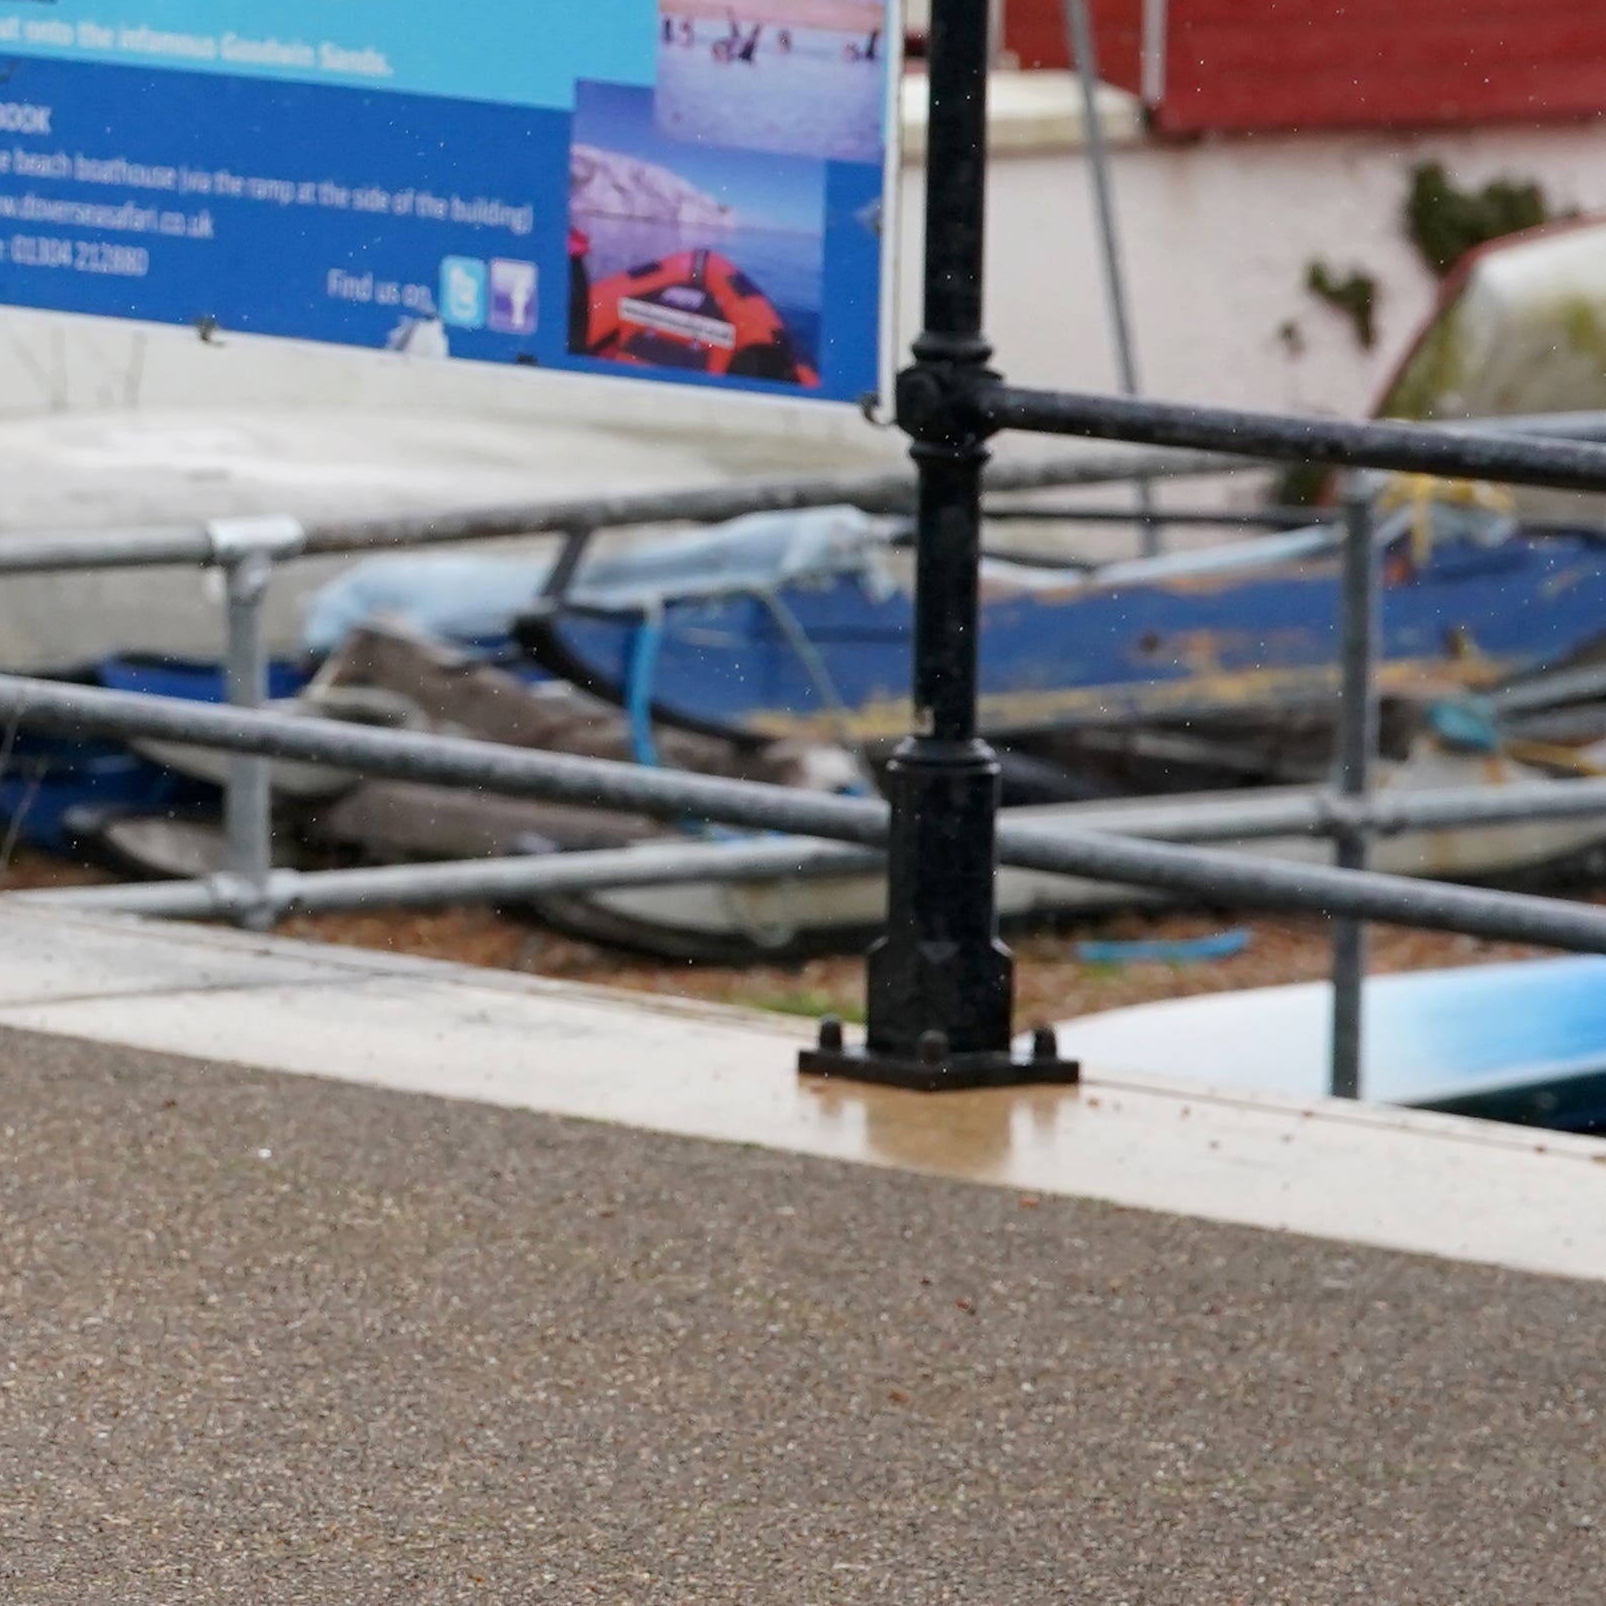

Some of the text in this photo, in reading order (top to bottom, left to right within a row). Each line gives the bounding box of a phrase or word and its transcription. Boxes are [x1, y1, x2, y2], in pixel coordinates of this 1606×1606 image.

[24, 21, 74, 45] onto
[77, 20, 114, 48] the
[119, 25, 216, 58] infamous
[221, 33, 314, 66] Goodwin
[13, 147, 73, 180] beach
[74, 152, 176, 191] boathouse
[213, 168, 244, 196] the
[246, 176, 295, 206] ramp
[297, 180, 316, 205] at
[318, 180, 349, 210] the
[352, 186, 391, 214] side
[392, 188, 415, 216] of
[416, 193, 448, 221] the
[327, 267, 374, 303] Find
[375, 281, 401, 306] us
